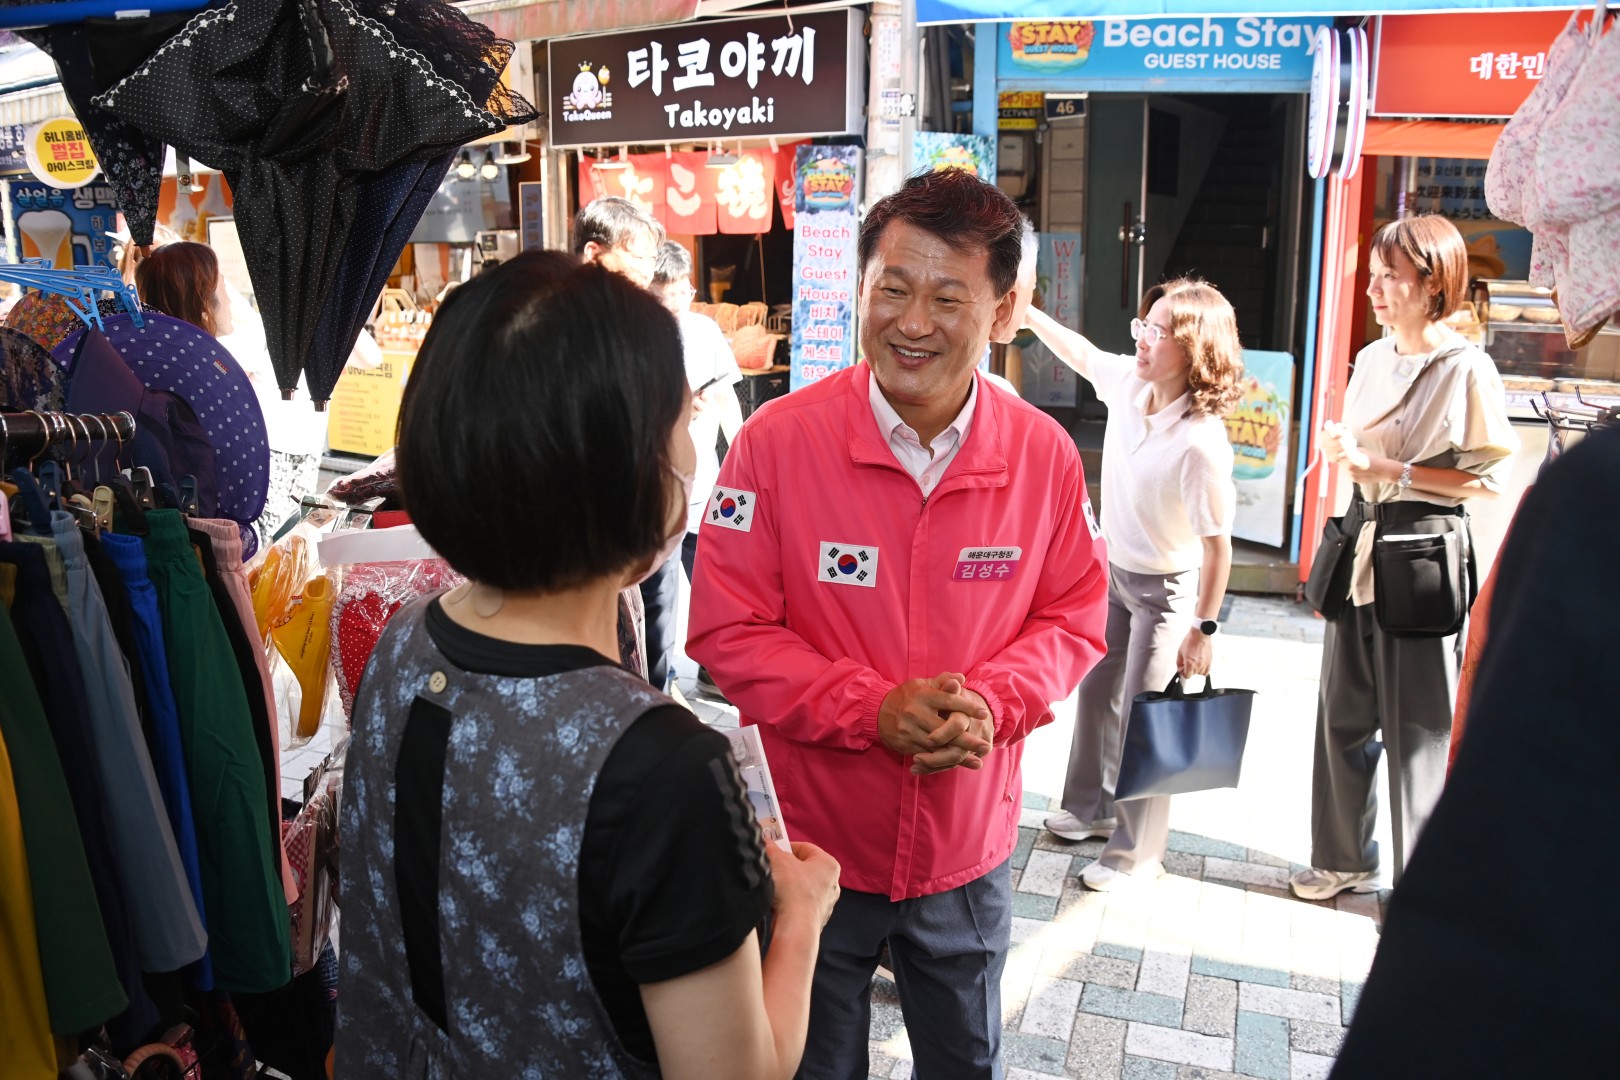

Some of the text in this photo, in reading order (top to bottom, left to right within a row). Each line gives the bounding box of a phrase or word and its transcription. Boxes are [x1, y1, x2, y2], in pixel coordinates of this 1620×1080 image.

[1021, 24, 1081, 44] STAY
[1104, 17, 1326, 55] Beach Stay
[627, 26, 816, 97] 타코야끼
[1144, 53, 1282, 69] GUEST HOUSE
[1469, 52, 1546, 80] 대한민
[664, 96, 774, 130] Takoyaki
[1056, 100, 1075, 115] 46
[562, 109, 612, 122] TakoQueen
[50, 142, 86, 160] 벌집
[46, 159, 95, 172] 아이스크림
[808, 179, 846, 192] STAY
[16, 187, 65, 208] 살얼음
[802, 225, 850, 238] Beach
[808, 245, 842, 260] Stay
[802, 266, 848, 280] Guest
[800, 287, 848, 301] House
[811, 306, 836, 319] 비치
[1052, 239, 1076, 383] WELCE
[804, 327, 843, 340] 스테이
[803, 346, 841, 360] 게스트
[1225, 419, 1270, 448] TAY
[961, 563, 1010, 579] 김성수
